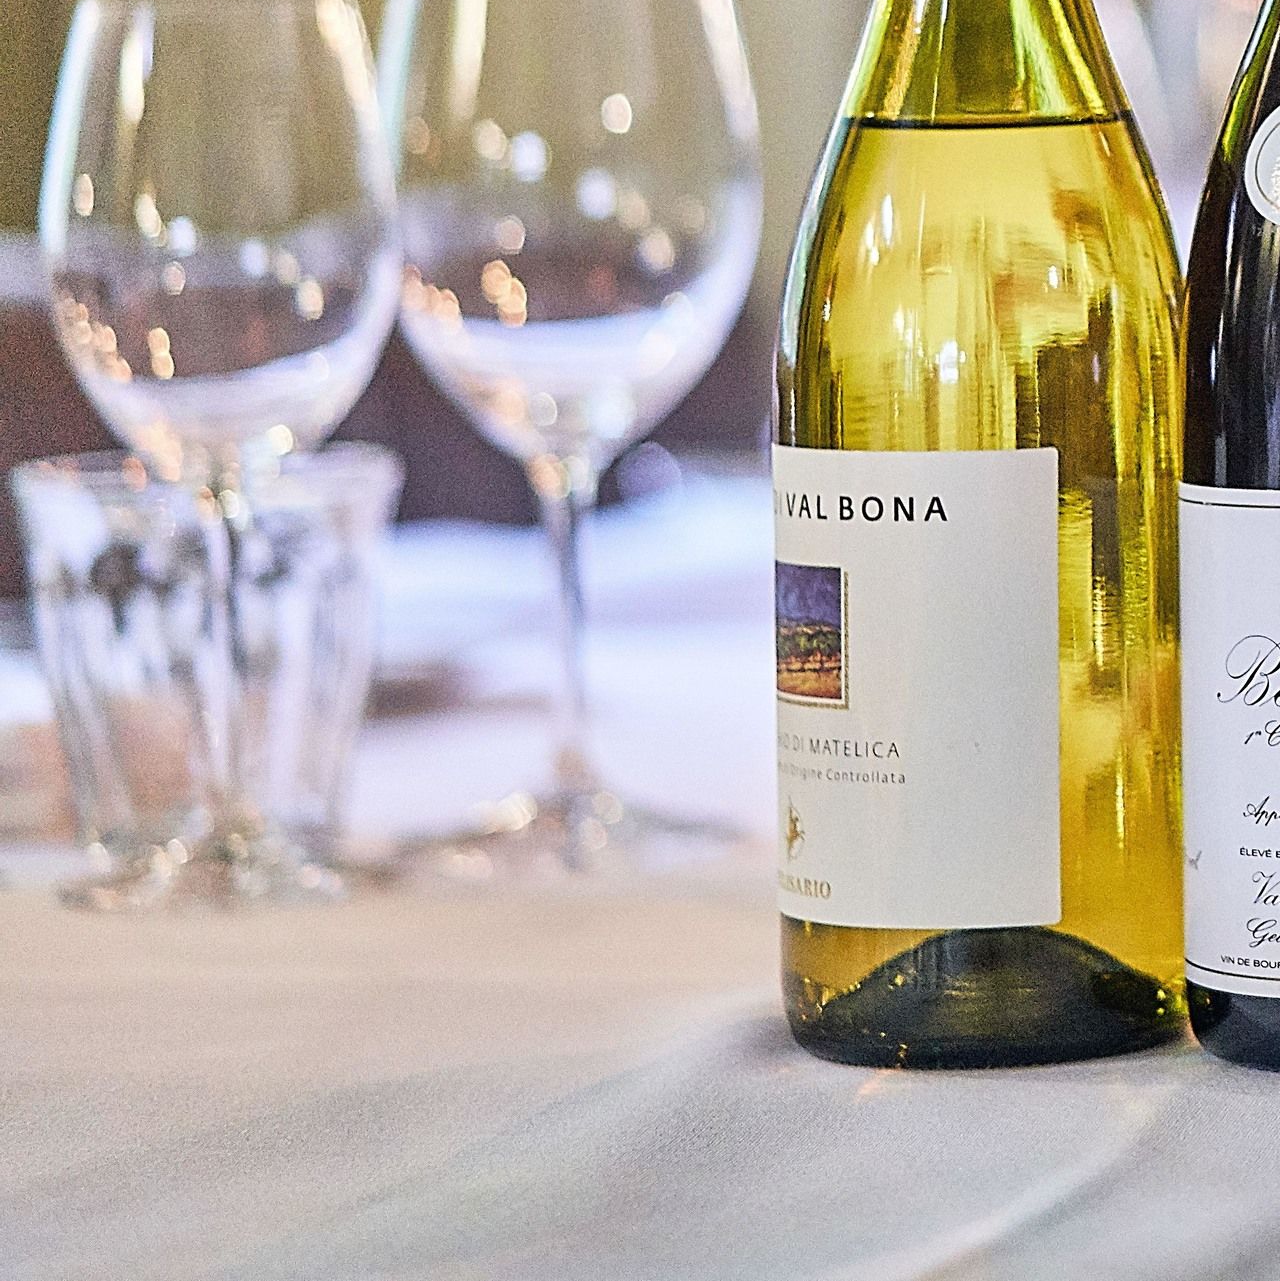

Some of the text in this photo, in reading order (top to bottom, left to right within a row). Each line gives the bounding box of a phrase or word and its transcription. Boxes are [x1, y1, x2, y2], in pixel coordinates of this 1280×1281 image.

[785, 492, 828, 520] VAL
[838, 495, 949, 522] BONA
[808, 737, 901, 760] MATELICA
[825, 768, 906, 785] Controllata
[1220, 955, 1235, 965] VIN
[1237, 958, 1250, 967] DE
